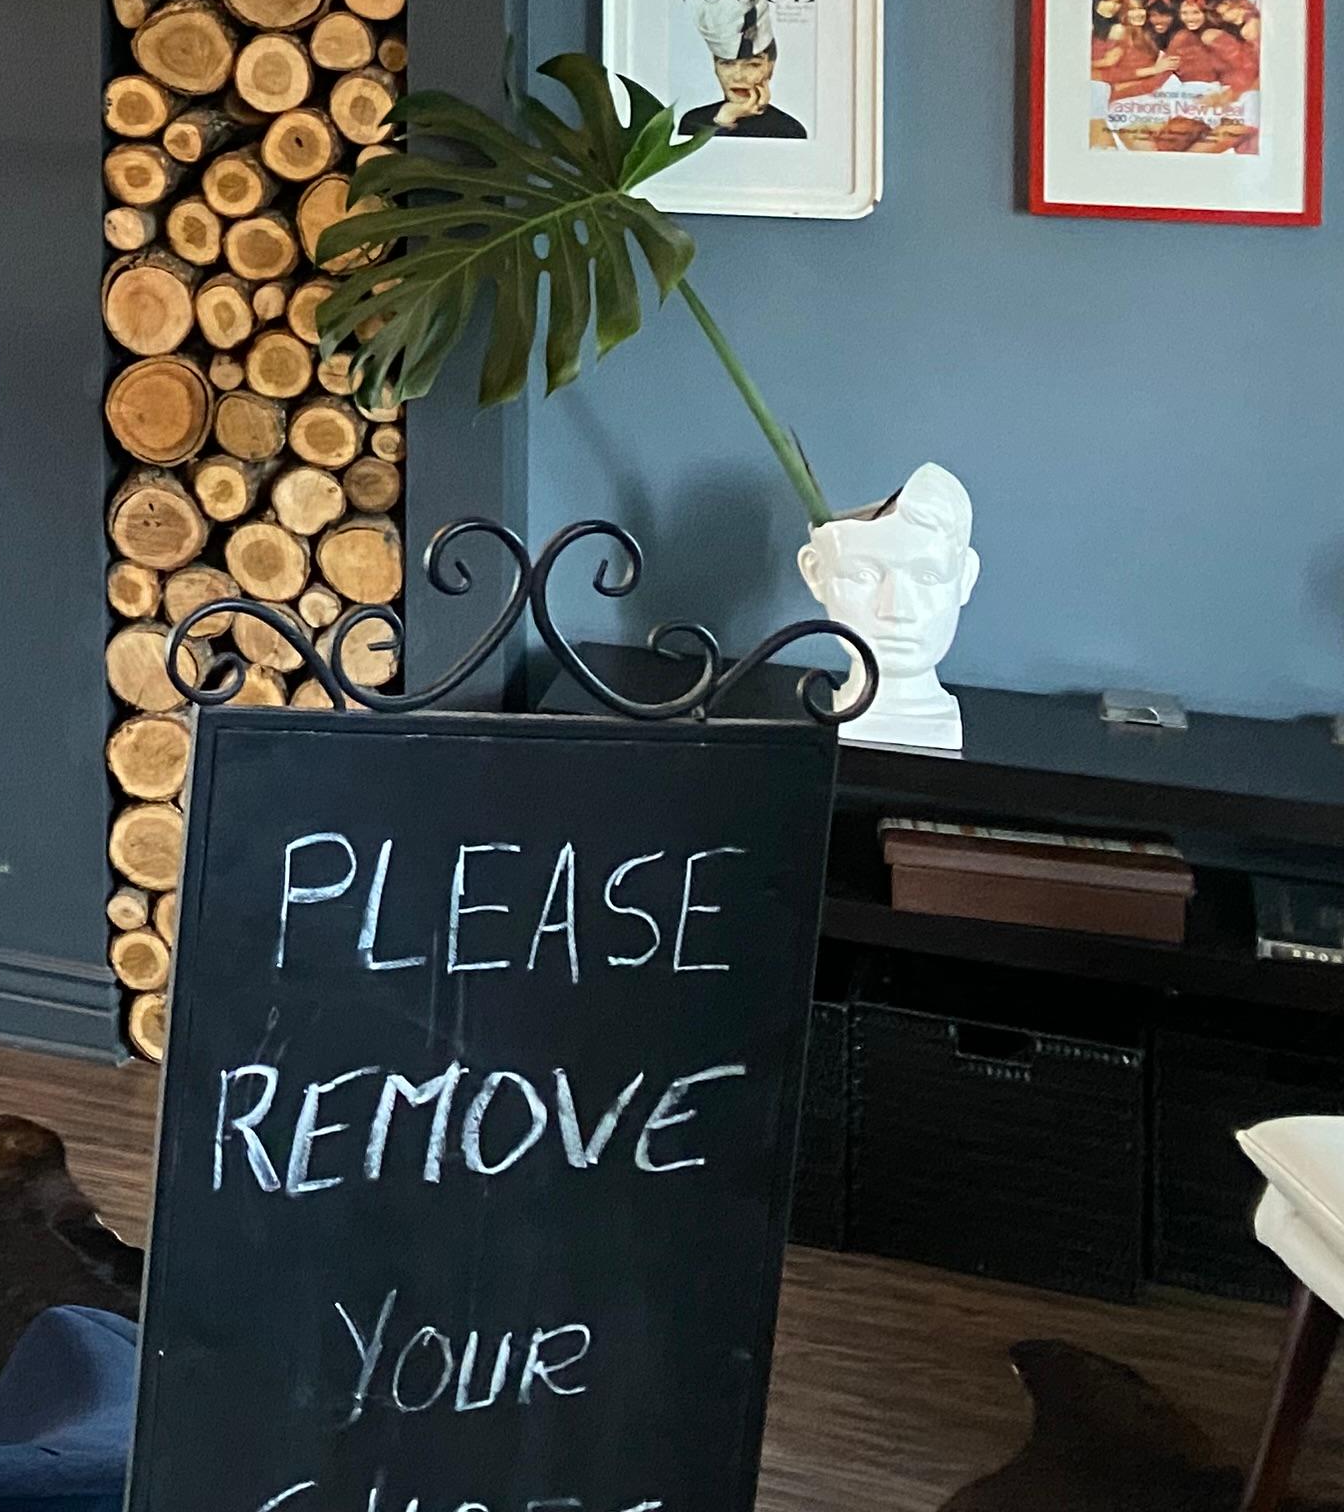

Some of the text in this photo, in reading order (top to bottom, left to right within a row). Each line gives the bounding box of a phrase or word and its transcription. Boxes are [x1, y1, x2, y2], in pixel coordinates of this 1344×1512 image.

[276, 832, 747, 985] PLEASE
[213, 1060, 749, 1196] REMOVE
[334, 1289, 592, 1423] YOUR
